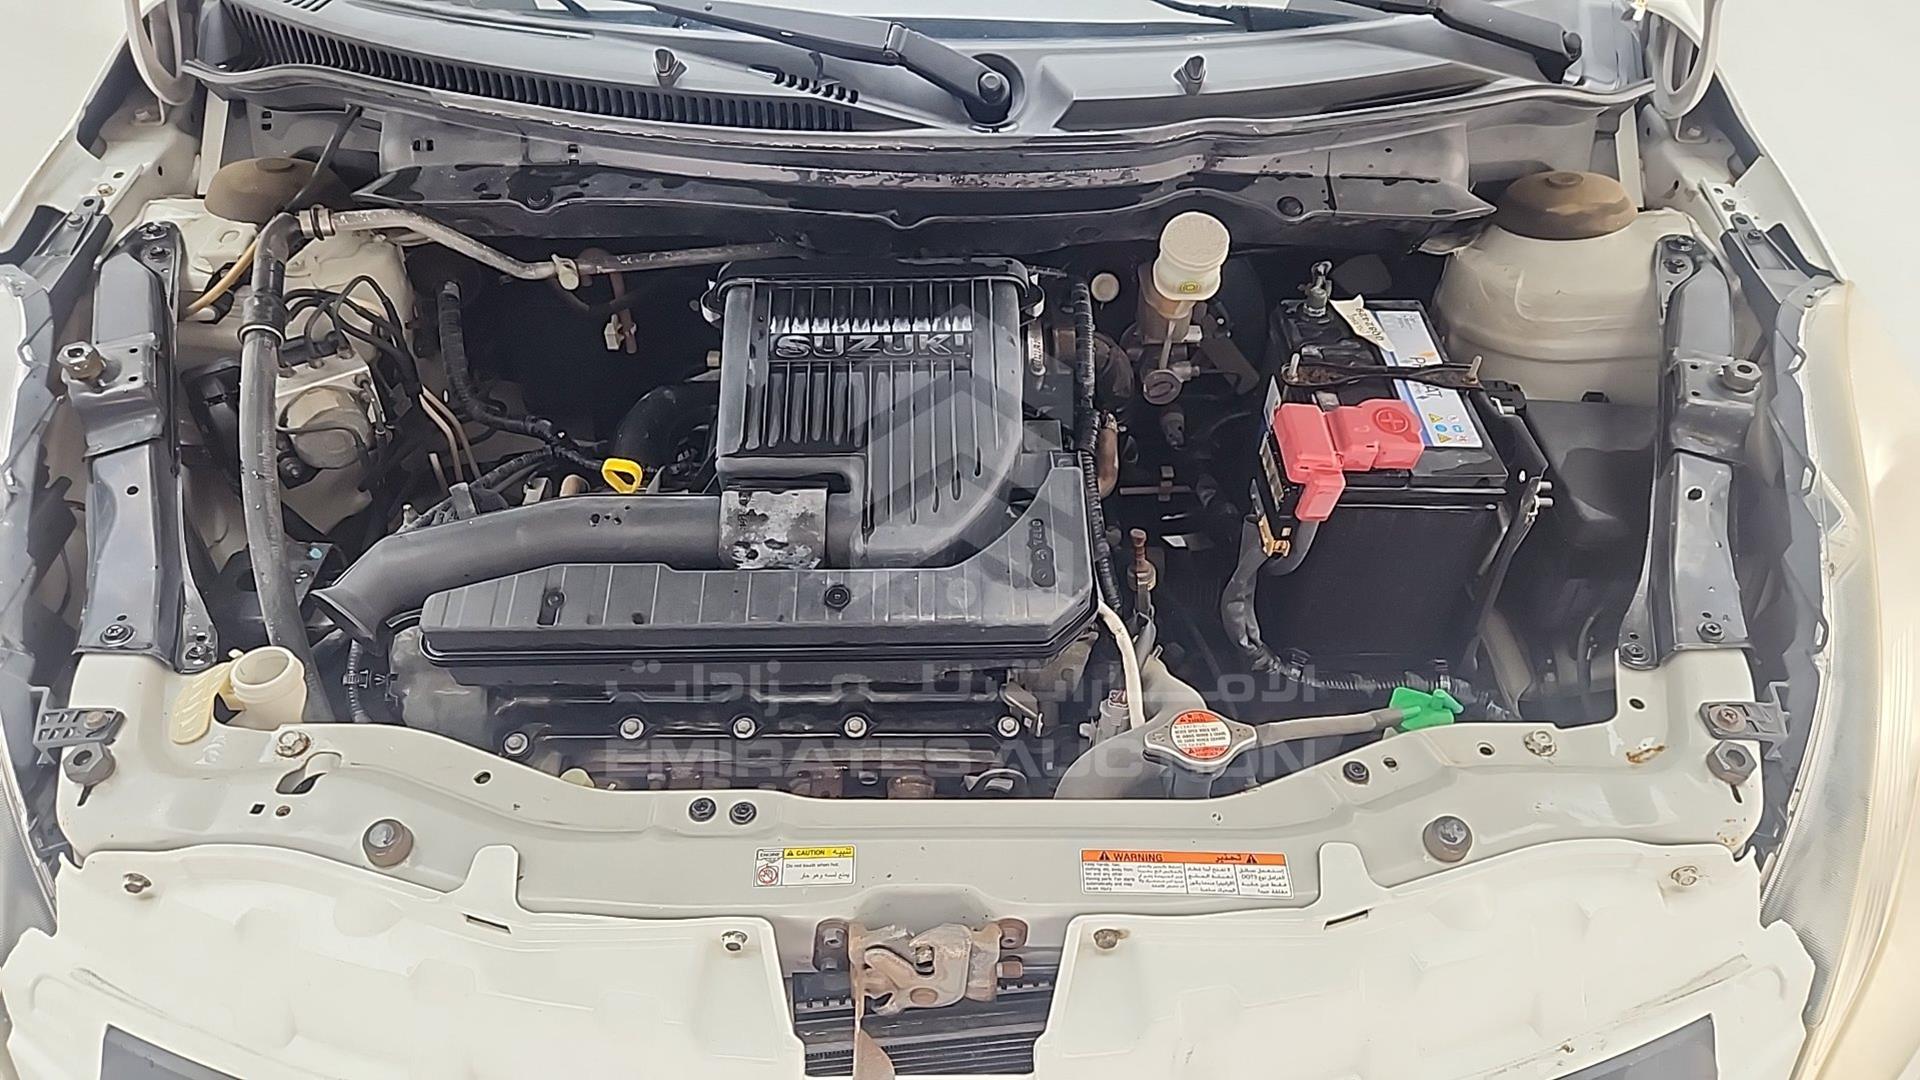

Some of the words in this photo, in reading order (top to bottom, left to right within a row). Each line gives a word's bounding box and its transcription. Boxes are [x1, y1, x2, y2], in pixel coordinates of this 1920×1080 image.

[776, 334, 967, 358] SUZUKI
[1113, 852, 1163, 862] WARNING
[1215, 853, 1242, 863] تحذير
